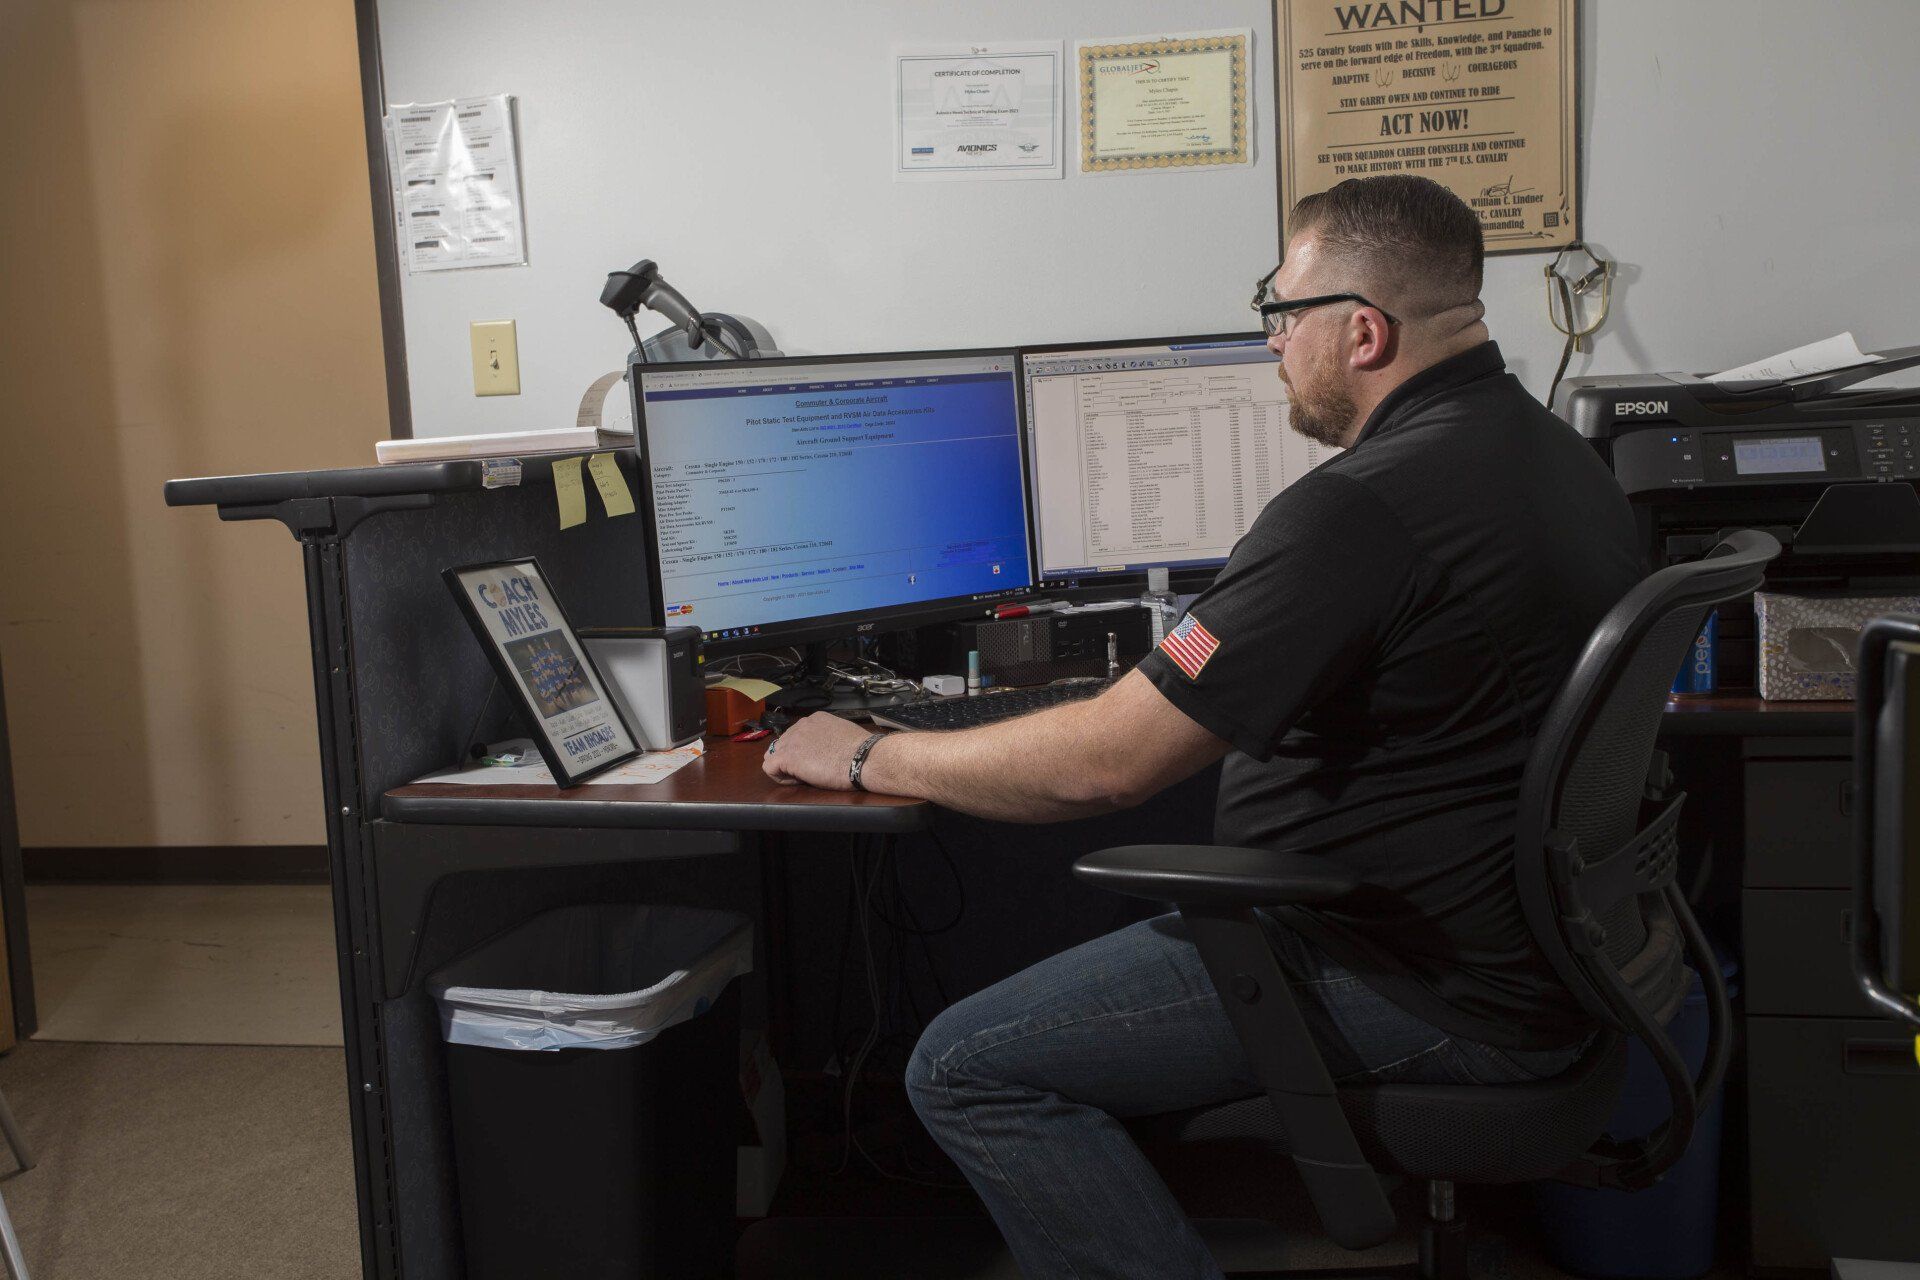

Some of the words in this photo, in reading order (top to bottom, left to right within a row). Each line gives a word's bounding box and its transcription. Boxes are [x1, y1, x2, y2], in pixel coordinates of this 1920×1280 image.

[1334, 0, 1506, 30] WANTED
[1299, 49, 1314, 58] 525
[1317, 45, 1345, 56] Cavalry
[1348, 43, 1372, 54] Scouts
[1375, 41, 1392, 51] with
[1396, 40, 1408, 49] the
[1411, 37, 1434, 47] Skills,
[1437, 33, 1484, 46] Knowledge,
[1488, 30, 1503, 41] and
[1506, 27, 1541, 39] Panache
[1544, 26, 1552, 36] to
[1301, 60, 1322, 71] serve
[1324, 59, 1334, 69] on
[1336, 58, 1348, 68] the
[1350, 55, 1382, 66] forward
[1384, 53, 1403, 64] edge
[1405, 51, 1413, 60] of
[1416, 48, 1453, 60] Freedom,
[1455, 46, 1473, 57] with
[1475, 45, 1487, 55] the
[1503, 41, 1544, 53] Squadron.
[981, 68, 1021, 76] COMPLETION
[1100, 63, 1144, 73] GLOBALJET
[1332, 73, 1370, 86] ADAPTIVE
[1402, 66, 1436, 79] DECISIVE
[1468, 60, 1518, 73] COURAGEOUS
[1340, 97, 1357, 108] STAY
[1359, 95, 1387, 106] GARRY
[1388, 93, 1411, 104] OWEN
[1412, 91, 1428, 102] AND
[1430, 88, 1466, 101] CONTINUE
[1468, 87, 1479, 97] TO
[1481, 85, 1500, 96] RIDE
[1380, 112, 1414, 137] ACT
[1420, 108, 1469, 133] NOW!
[957, 144, 998, 152] AVIONICS
[1317, 152, 1330, 164] SEE
[1332, 151, 1353, 163] YOUR
[1354, 148, 1395, 161] SQUADRON
[1396, 146, 1426, 158] CAREER
[1471, 141, 1487, 152] AND
[1489, 138, 1526, 150] CONTINUE
[1335, 165, 1345, 175] TO
[1347, 163, 1368, 174] MAKE
[1370, 160, 1403, 172] HISTORY
[1405, 158, 1426, 169] WITH
[1429, 157, 1443, 168] THE
[1445, 155, 1457, 166] 7TH
[1459, 154, 1474, 165] U.S.
[1476, 152, 1509, 164] CAVALRY
[1471, 197, 1501, 207] William
[1503, 195, 1510, 205] C.
[1513, 194, 1544, 205] Lindner
[1490, 207, 1522, 219] CAVALRY
[795, 400, 828, 408] Commuter
[835, 397, 865, 406] Corporate
[866, 394, 888, 403] Aircraft
[1615, 400, 1669, 416] EPSON
[746, 418, 762, 426] Pitot
[762, 416, 781, 425] Static
[782, 415, 795, 423] Test
[796, 413, 830, 423] Equipment
[831, 411, 842, 420] and
[844, 410, 862, 419] RVSM
[863, 409, 871, 417] Air
[873, 409, 887, 417] Data
[887, 407, 922, 416] Accessories
[797, 438, 819, 446] Aircraft
[820, 436, 841, 444] Ground
[841, 434, 863, 443] Support
[864, 432, 895, 441] Equipment
[499, 602, 549, 638] MYLES
[857, 622, 875, 632] acer
[563, 736, 589, 757] TEAM
[584, 725, 617, 749] RHOADES
